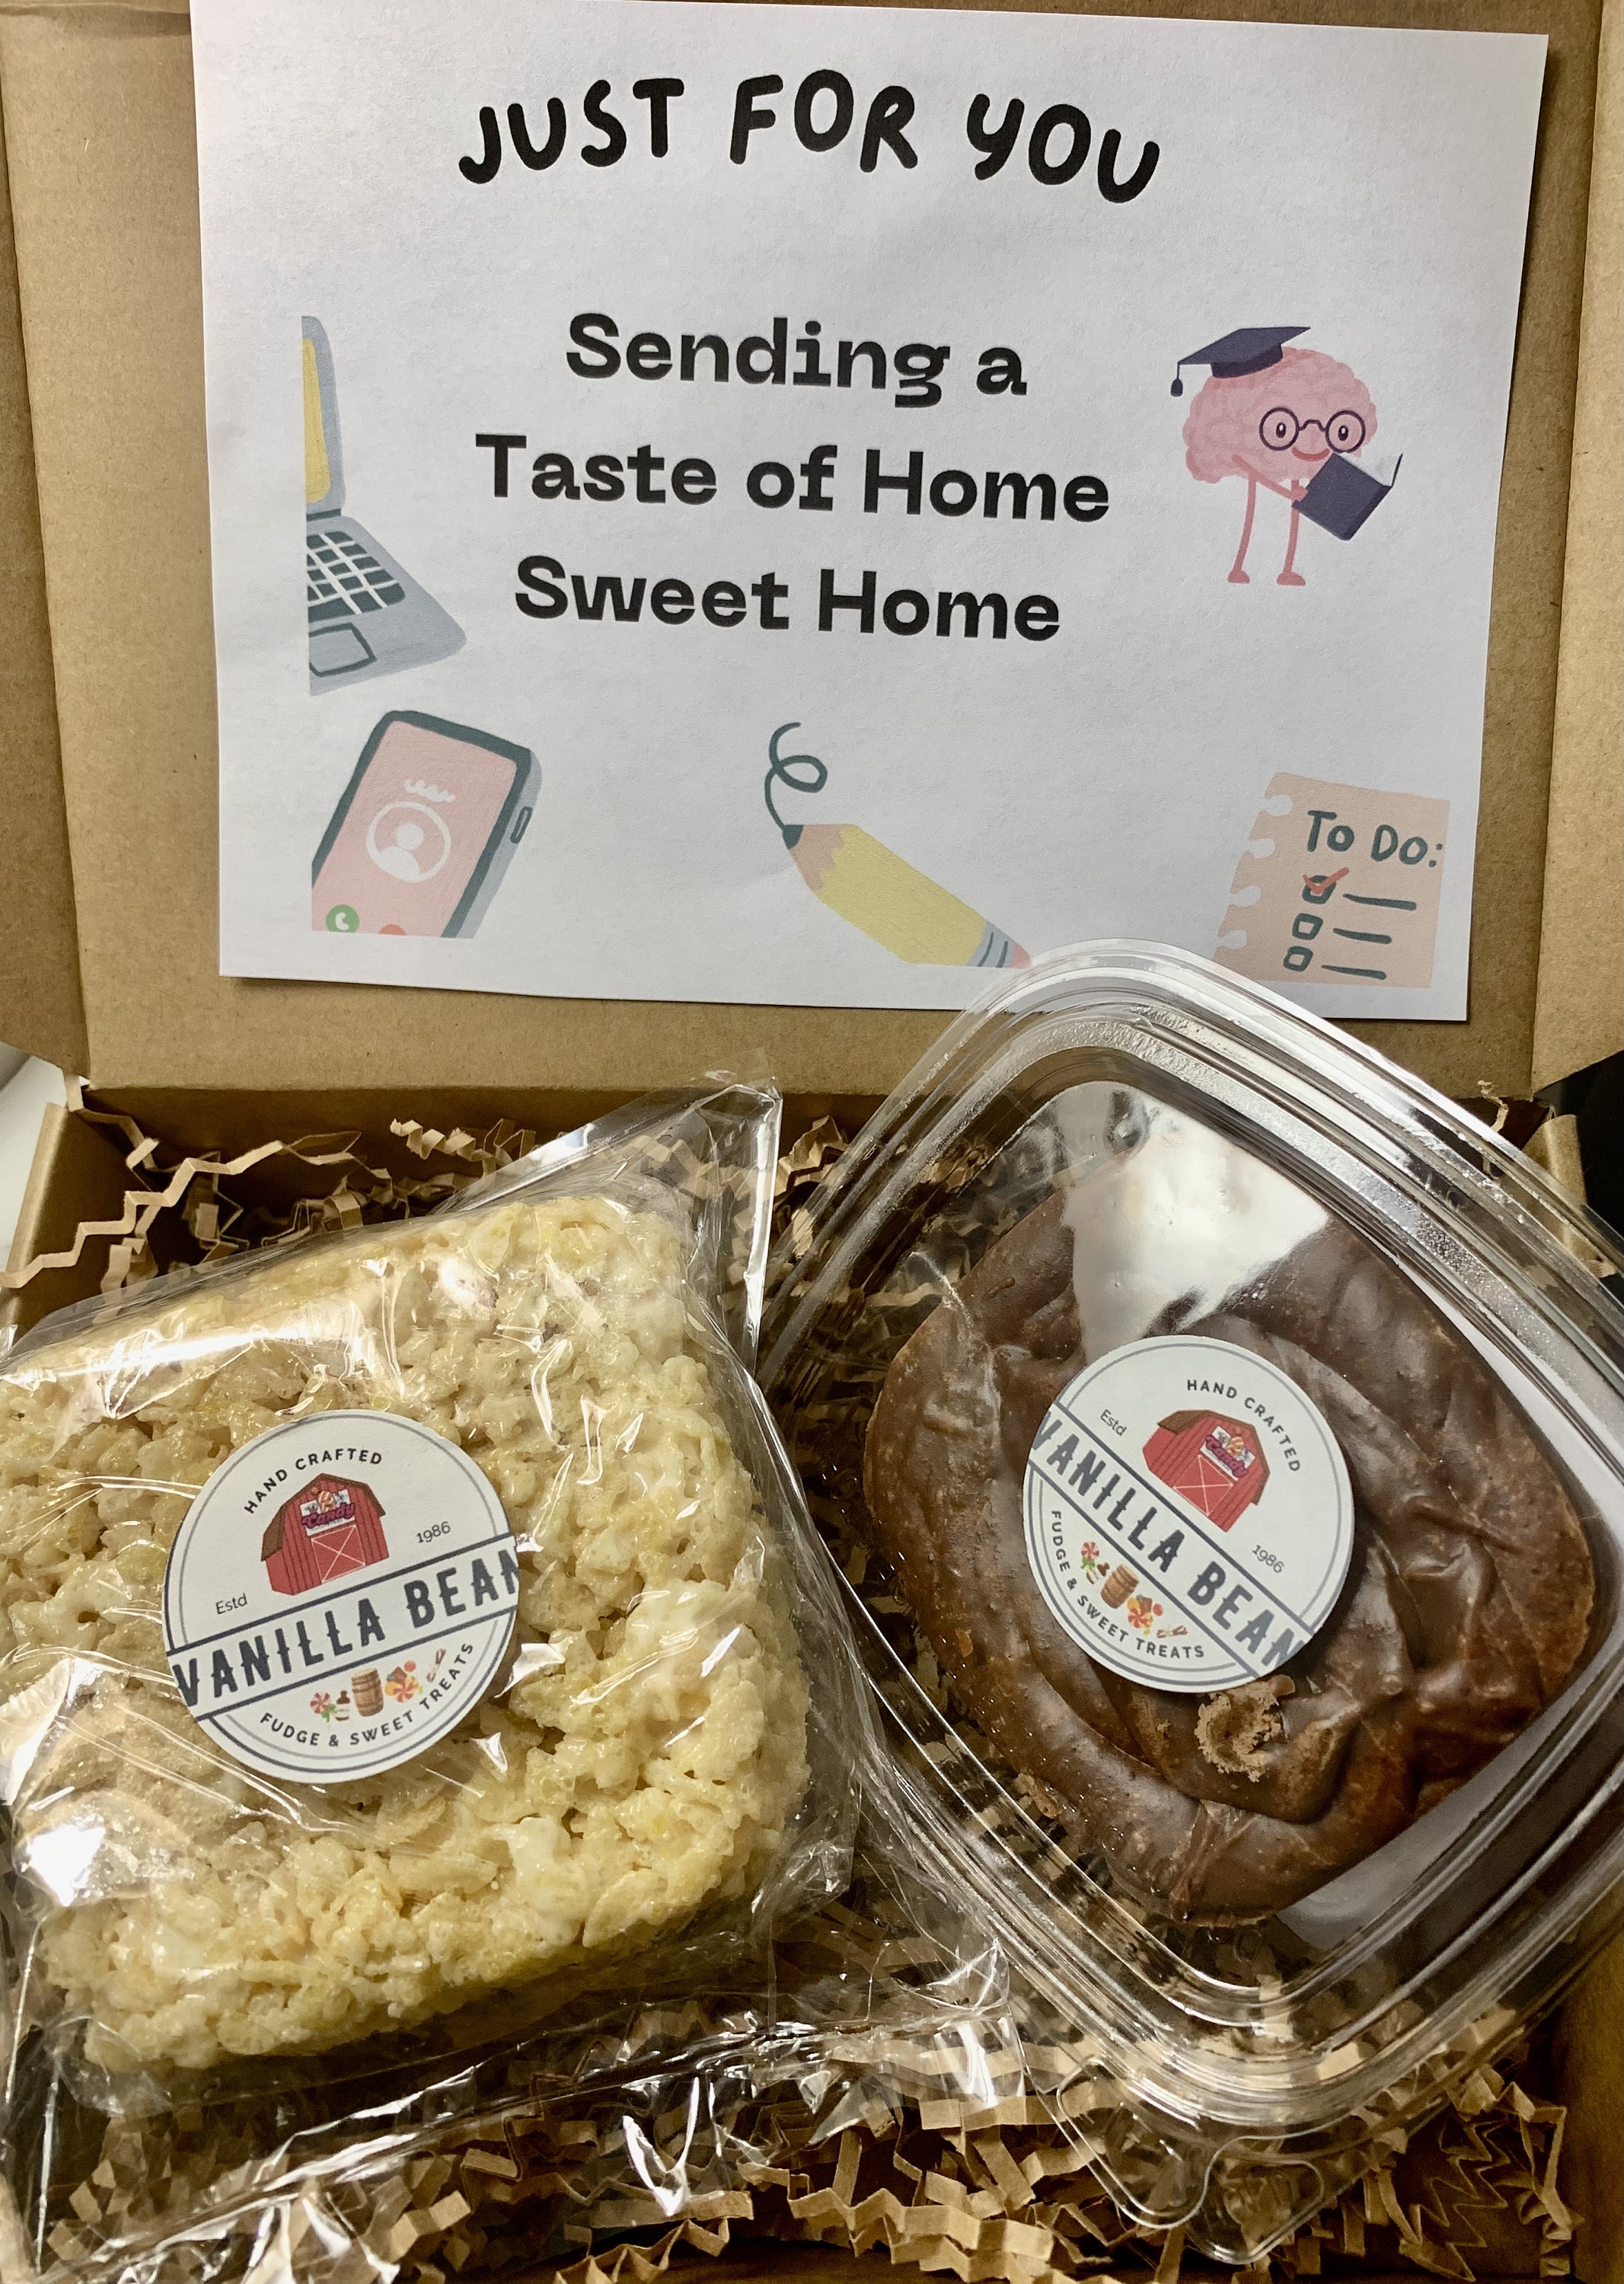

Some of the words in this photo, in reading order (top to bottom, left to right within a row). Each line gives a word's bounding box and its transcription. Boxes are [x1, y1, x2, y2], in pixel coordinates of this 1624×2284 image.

[459, 78, 684, 184] JUST
[729, 69, 918, 173] FOR
[966, 93, 1160, 203] YOU
[566, 312, 951, 408] Sending
[976, 346, 1027, 396] a
[475, 433, 717, 505] Taste
[746, 445, 838, 511] of
[863, 448, 1109, 522] Home
[515, 555, 790, 630] Sweet
[818, 569, 1061, 642] Home
[1307, 809, 1355, 853] To
[1370, 824, 1444, 868] Do:
[1099, 1408, 1128, 1437] Estd
[1186, 1379, 1238, 1400] HAND
[1244, 1396, 1301, 1472] CRAFTED
[244, 1469, 289, 1514] HAND
[295, 1447, 384, 1471] CRAFTED
[416, 1521, 452, 1544] 1986
[1032, 1410, 1185, 1574] VANILLA
[1187, 1561, 1306, 1668] BEAN
[1252, 1544, 1286, 1574] 1986
[215, 1593, 248, 1615] Estd
[1051, 1510, 1070, 1573] FUDGE
[1067, 1577, 1079, 1590] &
[1077, 1594, 1128, 1643] SWEET
[1135, 1637, 1205, 1659] TREATS
[172, 1598, 386, 1708] VANILLA
[260, 1712, 321, 1746] FUDGE
[328, 1734, 340, 1747] &
[349, 1710, 414, 1746] SWEET
[419, 1641, 474, 1711] TREATS
